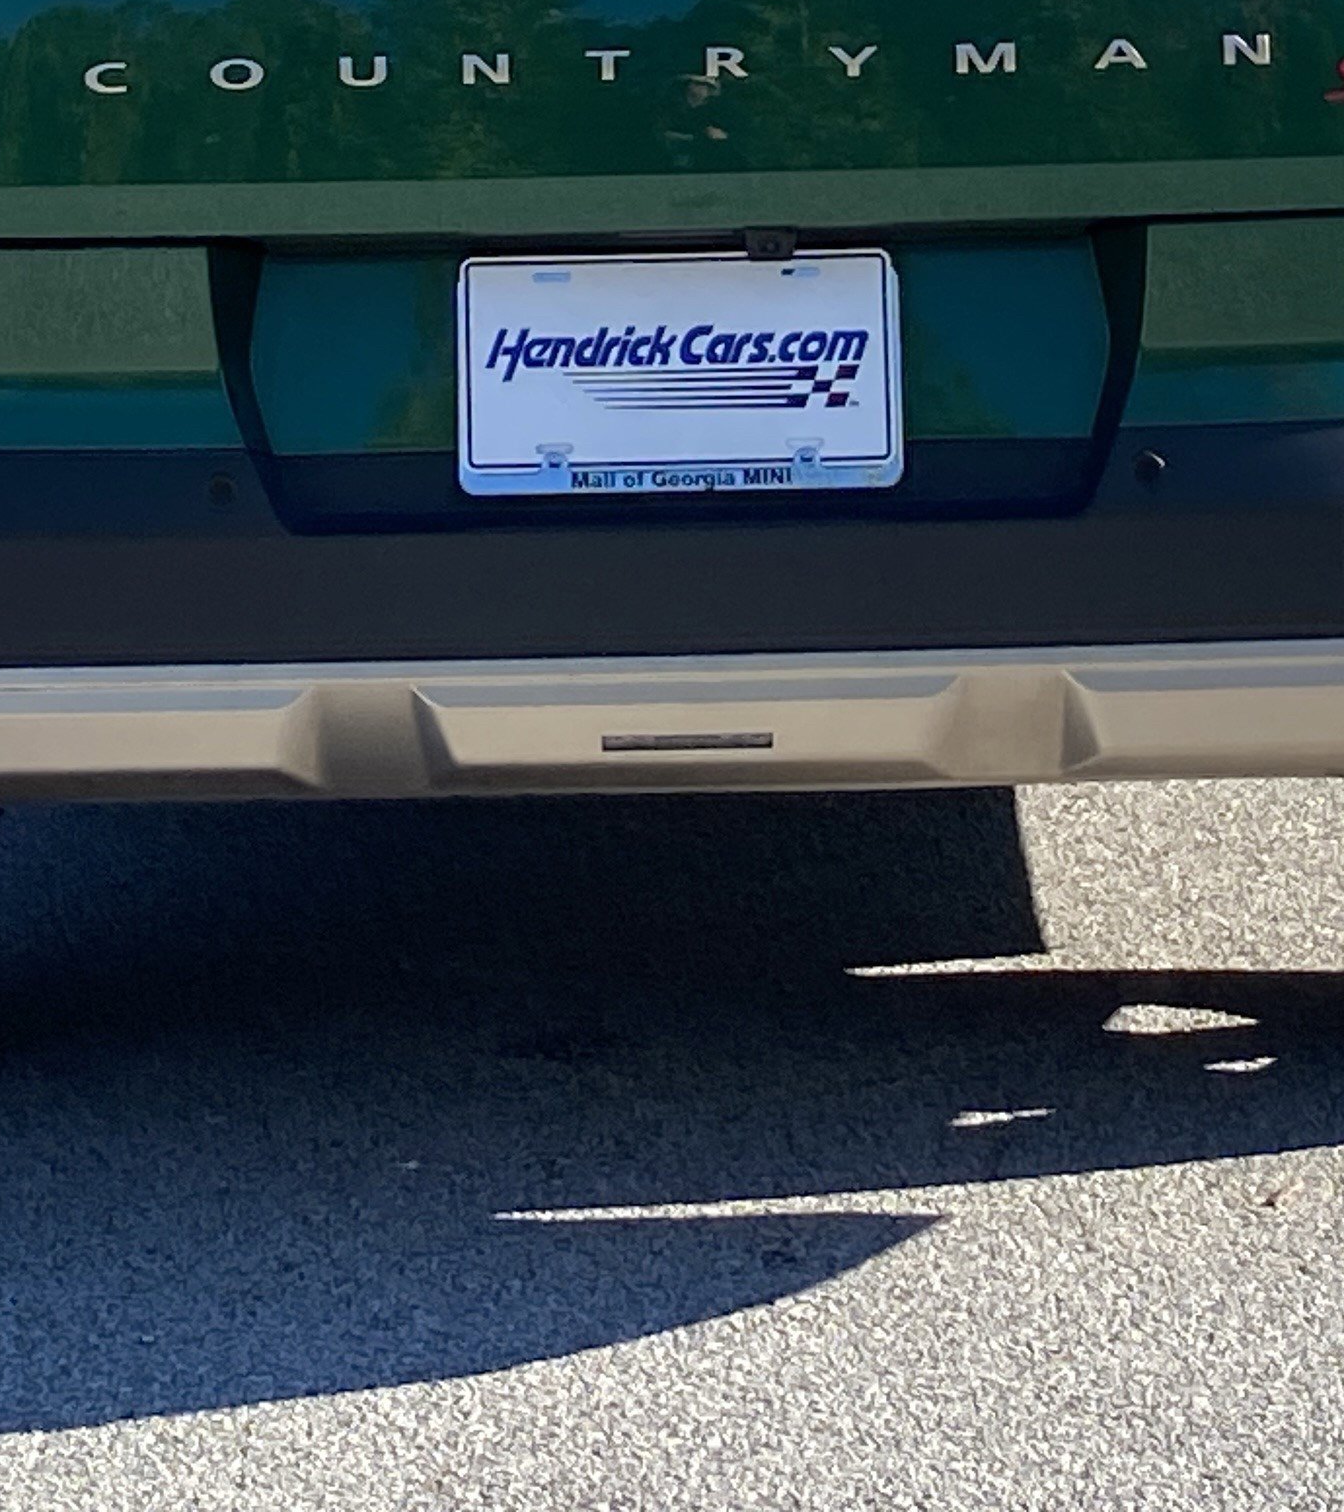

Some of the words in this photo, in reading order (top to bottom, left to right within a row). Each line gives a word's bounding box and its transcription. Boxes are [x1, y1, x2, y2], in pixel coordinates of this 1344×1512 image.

[83, 33, 1271, 94] COUNTRYMAN
[571, 471, 616, 488] Mall
[623, 470, 644, 487] of
[652, 469, 735, 491] Georgia
[743, 467, 792, 484] MINI
